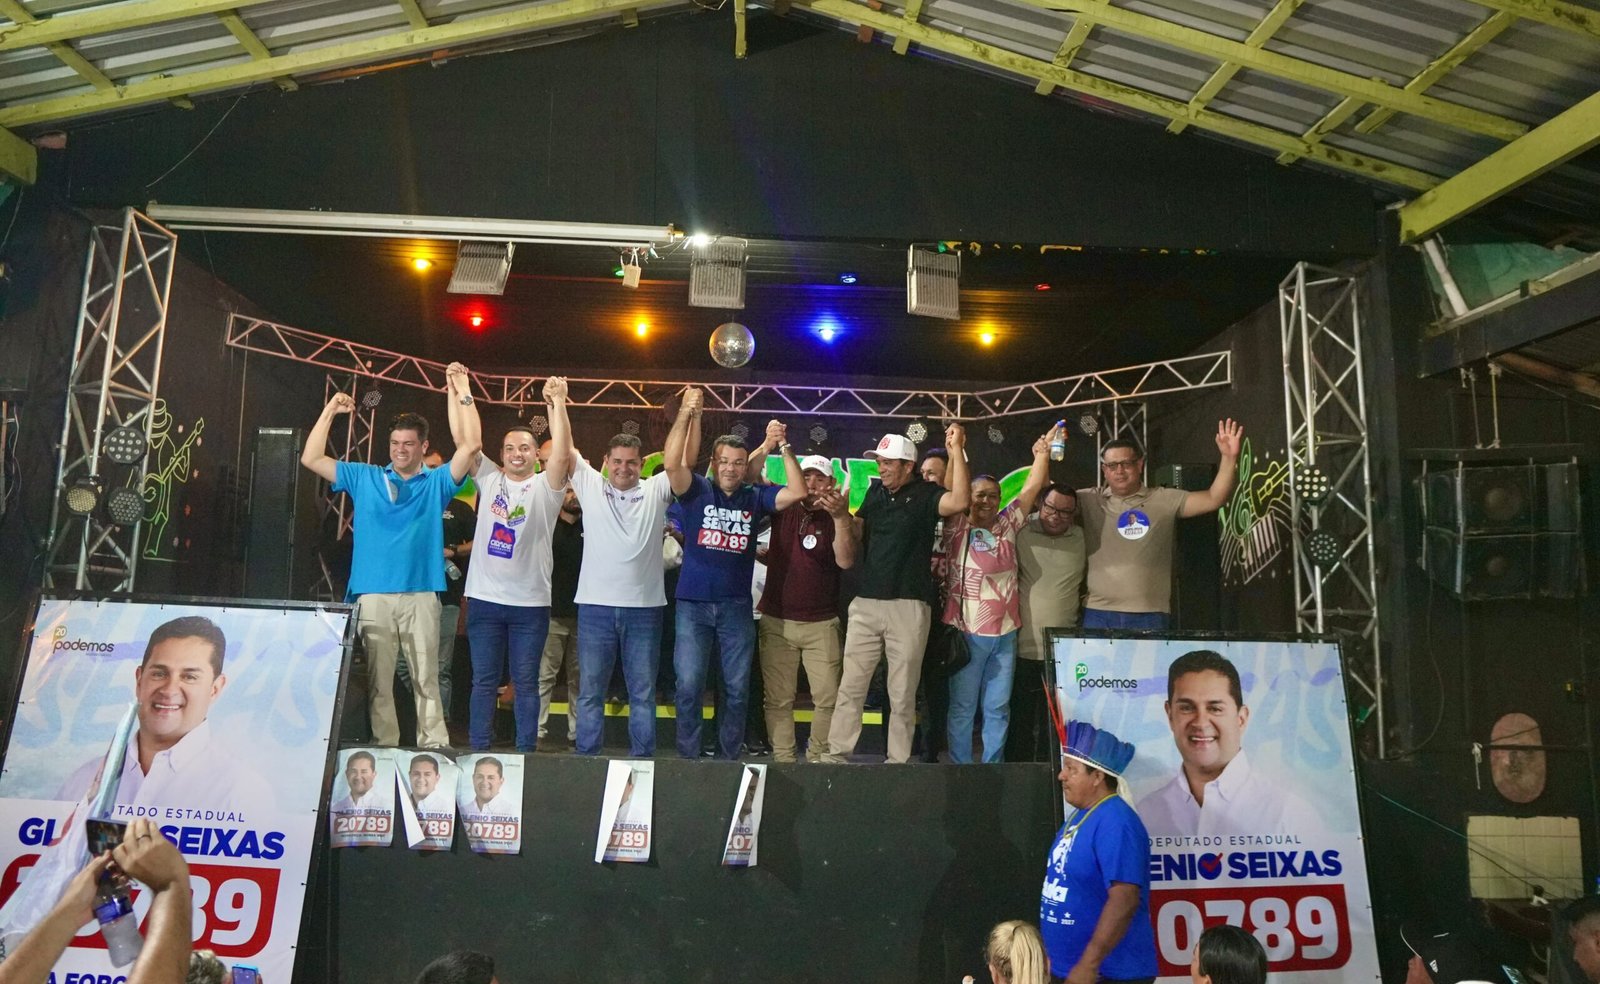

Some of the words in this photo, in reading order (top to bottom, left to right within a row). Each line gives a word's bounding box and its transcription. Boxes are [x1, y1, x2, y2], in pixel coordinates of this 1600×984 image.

[702, 516, 751, 535] SEIXAS
[701, 530, 748, 550] 20789
[55, 627, 66, 637] 20
[52, 637, 115, 654] podemos
[1076, 665, 1087, 675] 20
[1079, 675, 1138, 692] podemos
[165, 808, 245, 823] ESTADUAL
[337, 816, 388, 832] 20789
[160, 825, 285, 860] SEIXAS
[612, 831, 645, 847] 789
[1229, 835, 1302, 846] ESTADUAL
[1149, 852, 1223, 882] ENIO
[1227, 850, 1343, 879] SEIXAS
[1157, 895, 1339, 966] 0789
